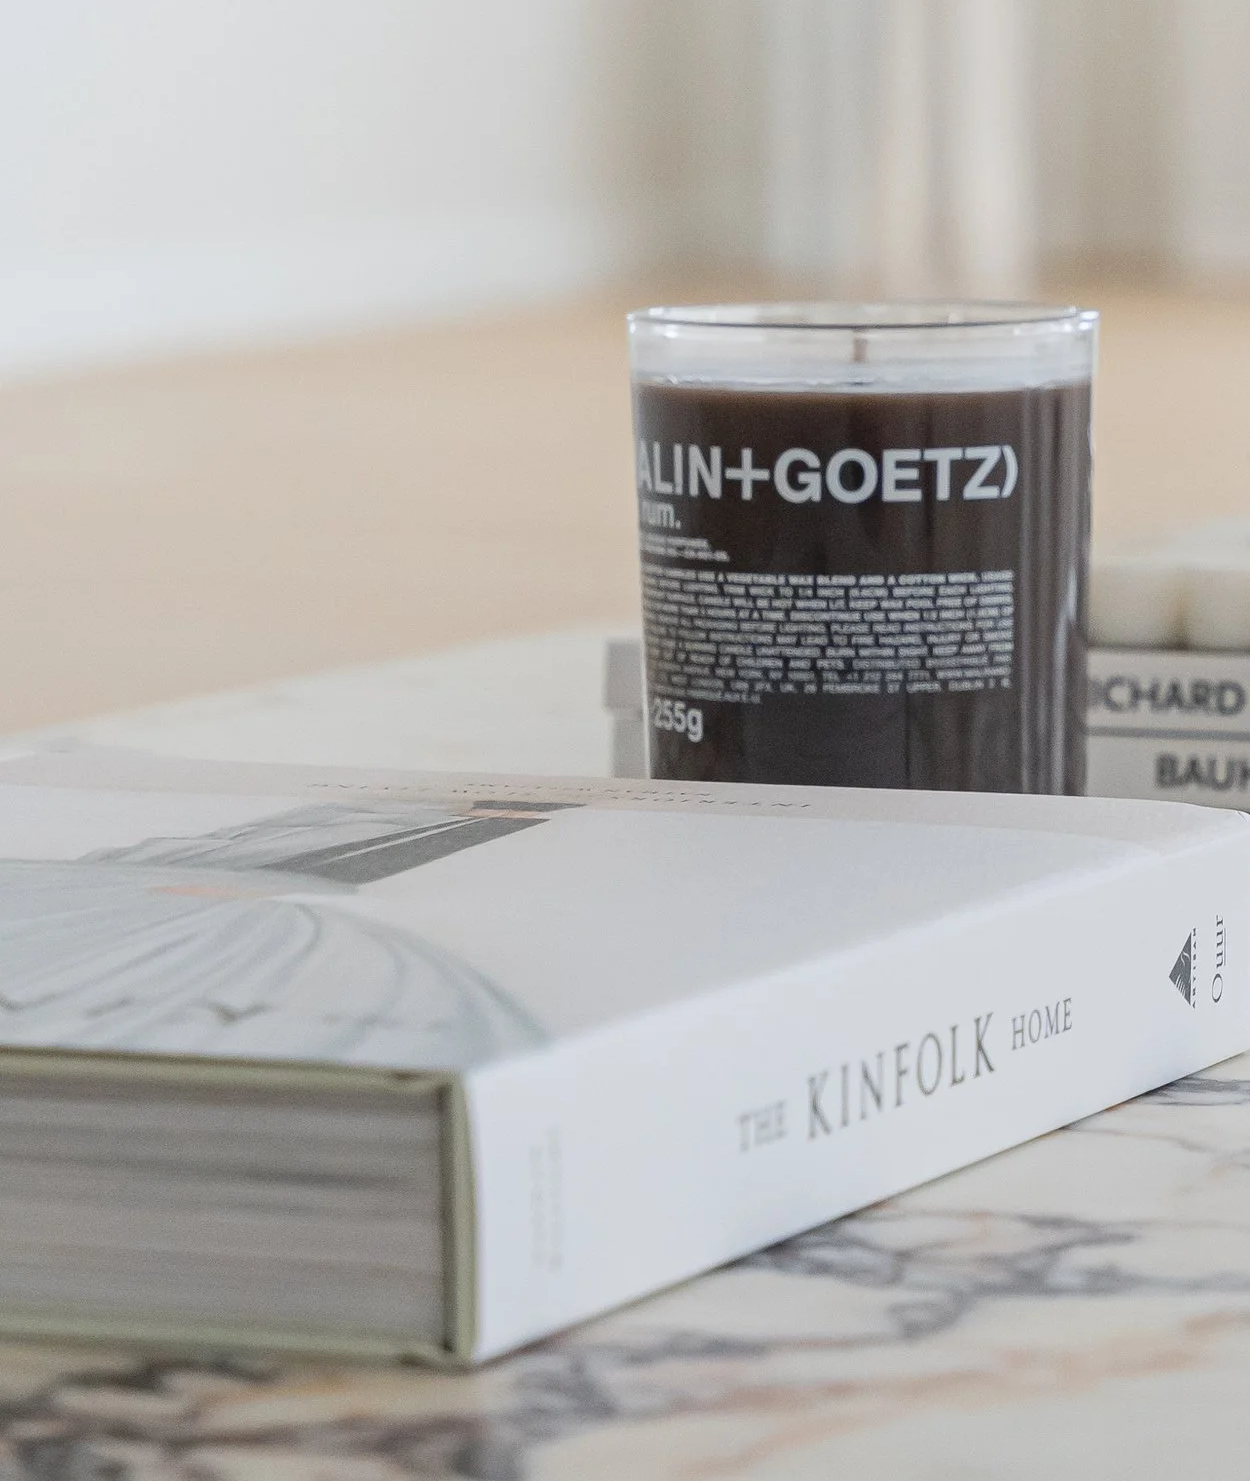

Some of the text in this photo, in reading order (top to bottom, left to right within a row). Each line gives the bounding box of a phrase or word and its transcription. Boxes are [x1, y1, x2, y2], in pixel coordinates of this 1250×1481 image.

[735, 997, 1074, 1153] THE KINFOLK HOME
